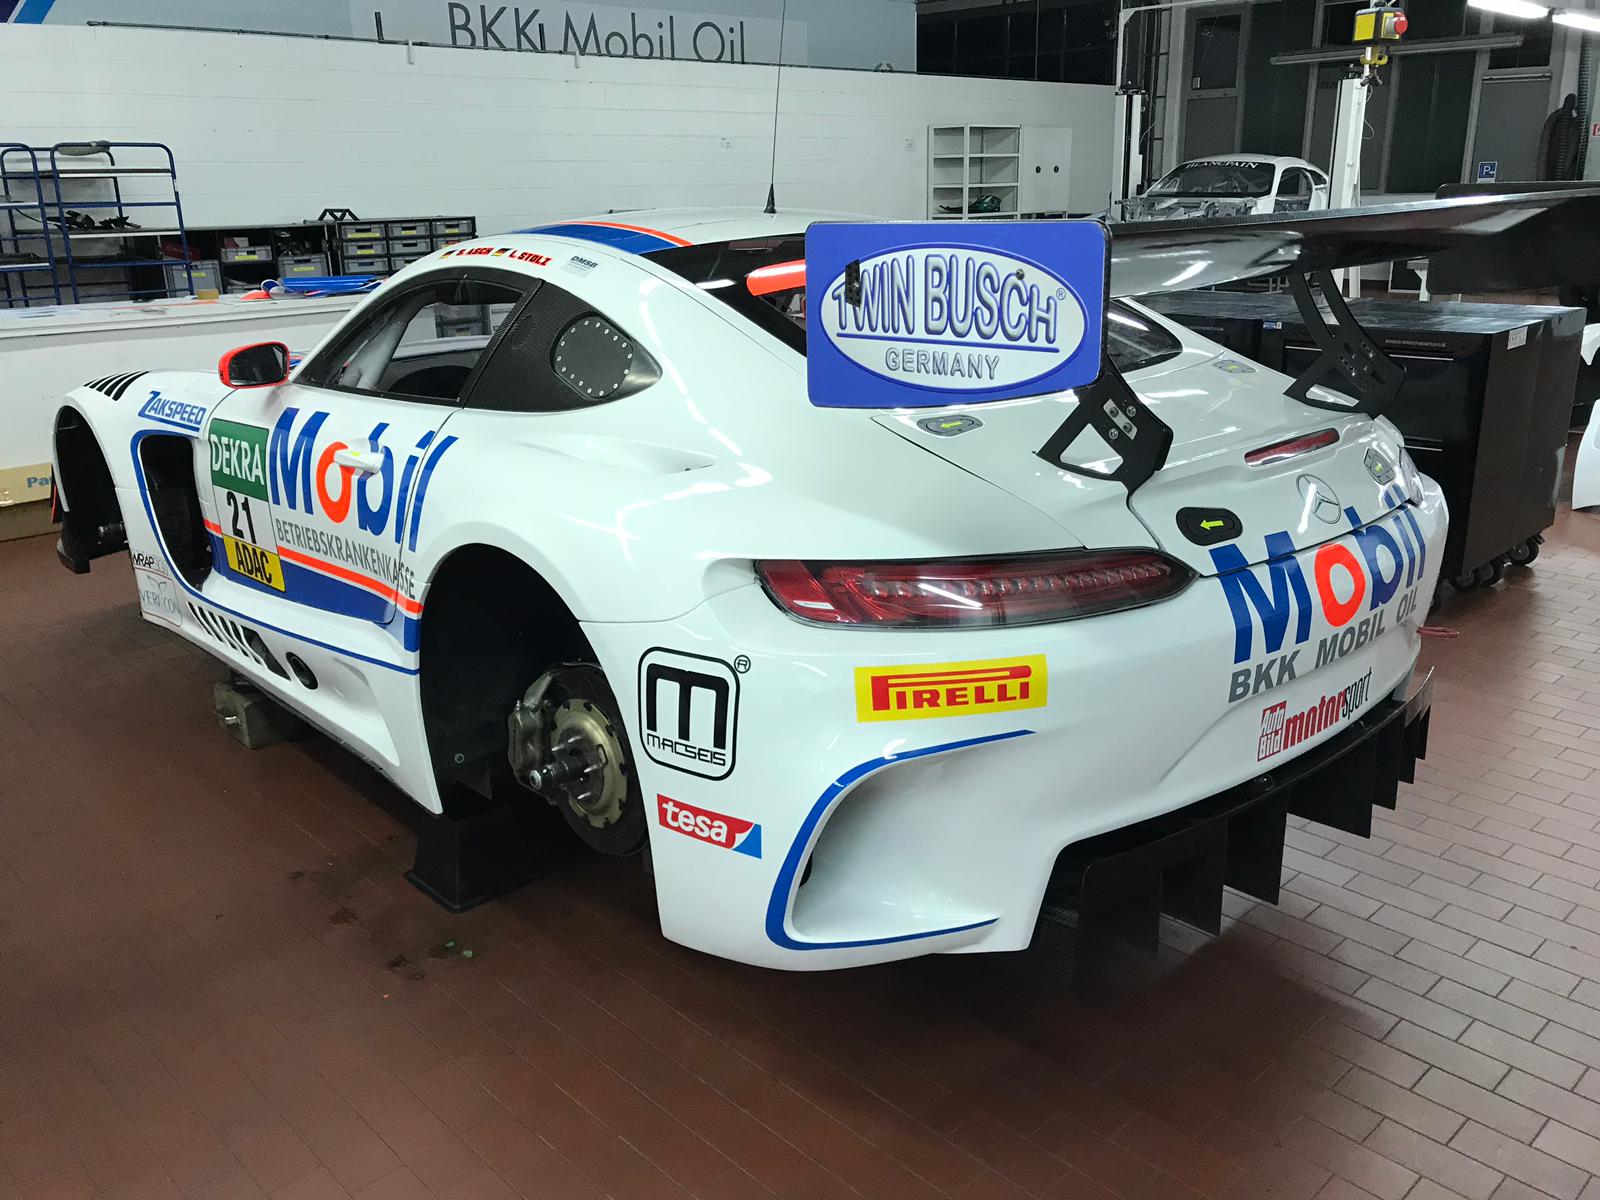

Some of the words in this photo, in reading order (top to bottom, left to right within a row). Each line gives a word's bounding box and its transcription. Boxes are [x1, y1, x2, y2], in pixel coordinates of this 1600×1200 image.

[447, 2, 541, 50] BKK
[562, 10, 676, 60] Mobil
[692, 21, 745, 64] Oil
[517, 252, 553, 267] STOLZ
[570, 255, 599, 269] DMSB
[924, 253, 1057, 344] BUSCH
[885, 346, 1000, 381] GERMANY
[138, 391, 207, 432] ZAKSPEED
[211, 434, 265, 486] DEKRA
[269, 406, 460, 553] Mobil
[227, 491, 257, 545] 21
[234, 541, 273, 585] ADAC
[275, 519, 416, 600] BETRIEBSKRANKENKASSE
[1209, 483, 1426, 665] Mobil
[1228, 649, 1301, 703] BKK
[1314, 609, 1386, 669] MOBIL
[1395, 586, 1417, 624] OIL
[871, 665, 1032, 711] PIRELLI
[646, 732, 727, 767] MACSEIS
[662, 801, 729, 844] tesa
